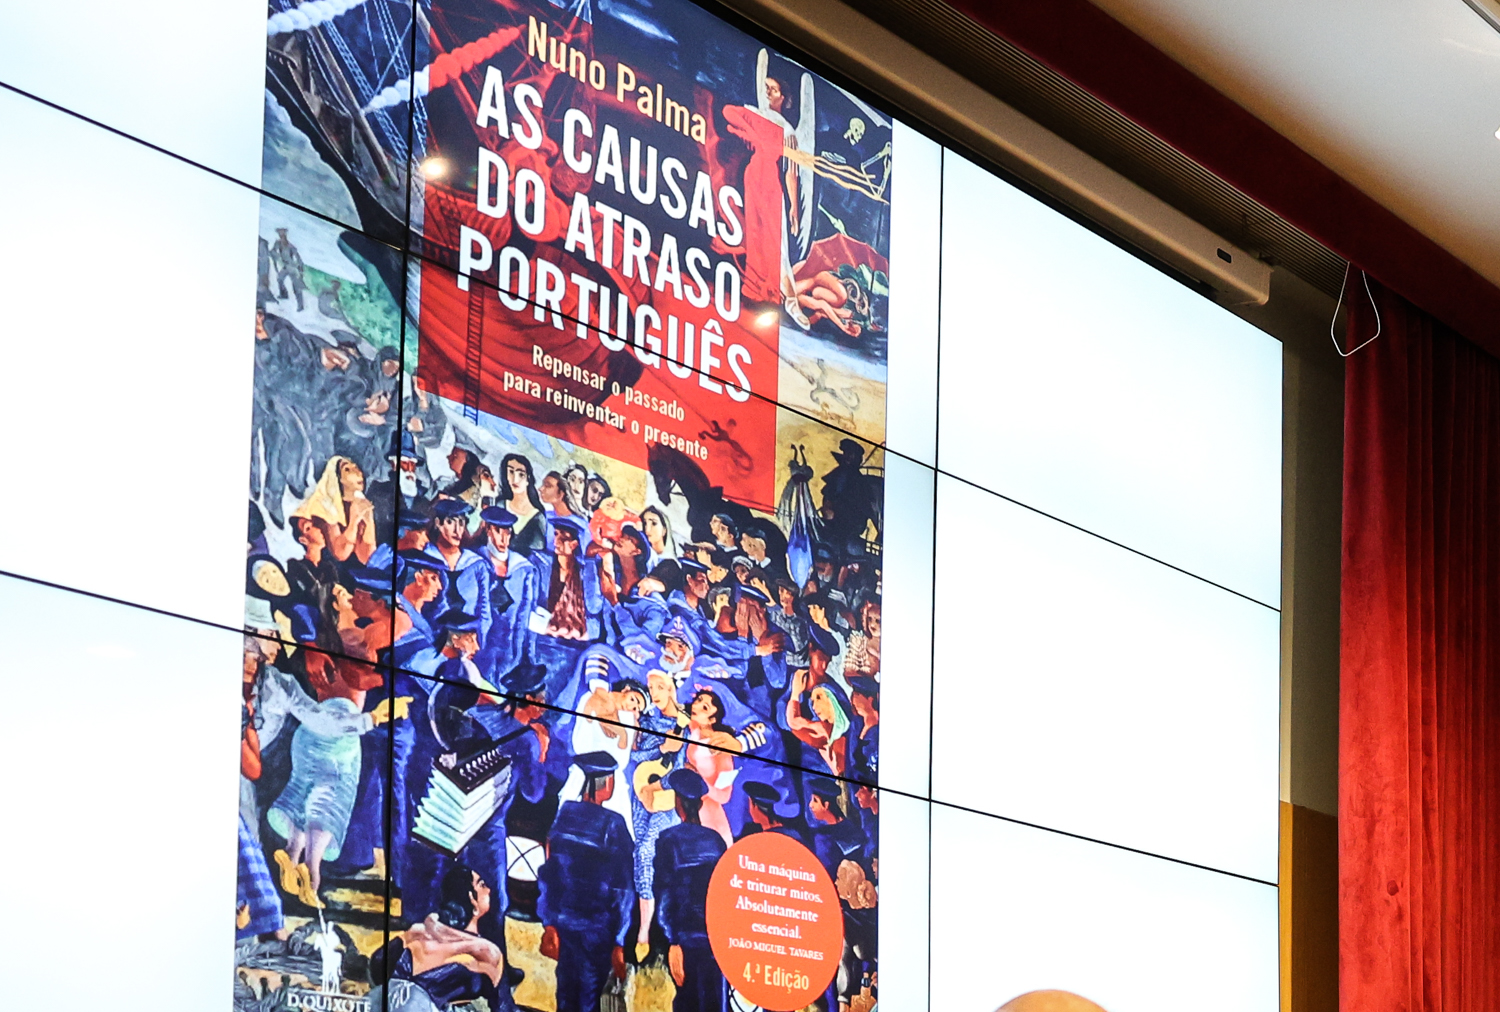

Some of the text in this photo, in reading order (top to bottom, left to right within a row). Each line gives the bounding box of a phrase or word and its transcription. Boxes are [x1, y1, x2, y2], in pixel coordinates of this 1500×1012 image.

[528, 15, 706, 145] Nuno Palma
[476, 65, 743, 246] AS CAUSAS
[477, 146, 741, 322] DO ATRASO
[457, 225, 752, 402] PORTUGUÊS
[532, 345, 685, 421] Repensar o passado
[504, 371, 708, 460] para reinventar o presente
[730, 873, 823, 903] de triturar mitos.
[738, 854, 816, 882] Uma máquina
[735, 895, 819, 922] Absolutamente
[751, 923, 802, 939] essencial.
[728, 937, 823, 960] JOÃO MIGUEL TAVARES
[764, 965, 809, 994] Edição
